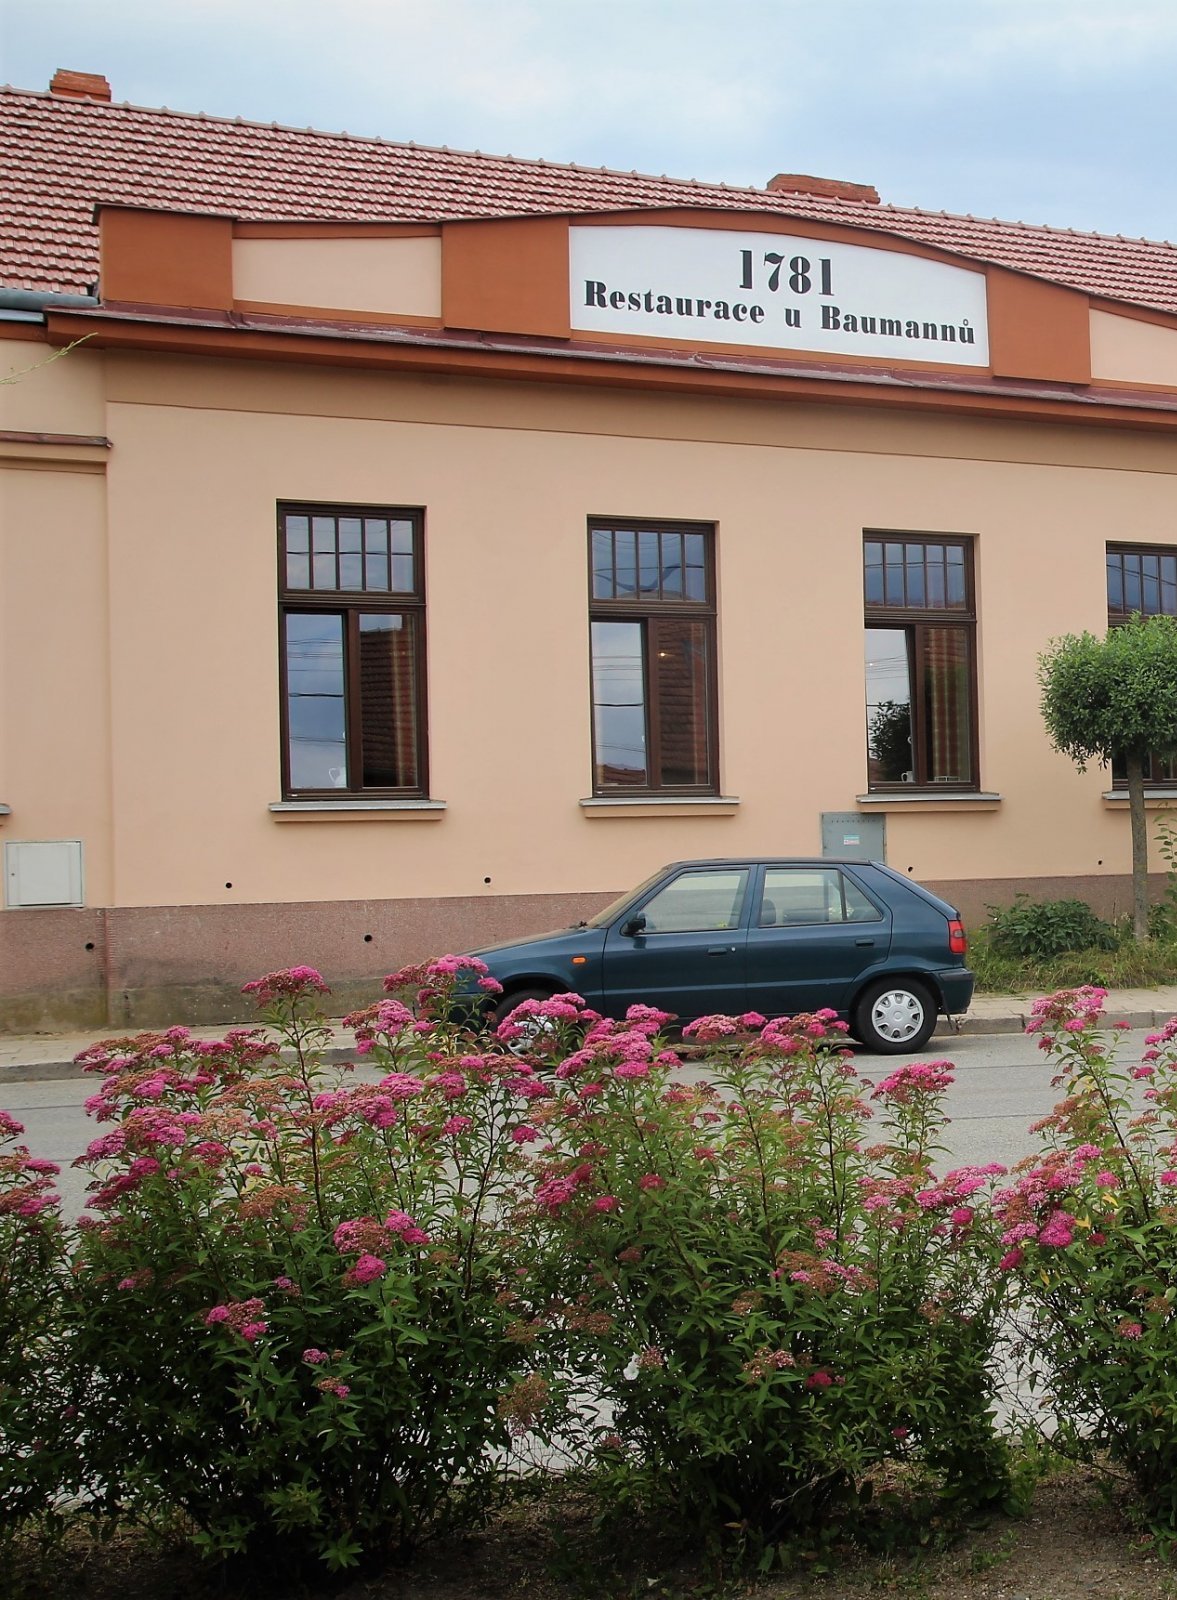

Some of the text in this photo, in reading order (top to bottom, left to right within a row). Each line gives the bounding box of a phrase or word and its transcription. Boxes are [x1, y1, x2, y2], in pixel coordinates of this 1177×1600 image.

[739, 250, 834, 296] 1781
[584, 280, 975, 344] Restaurace u Baumannů
